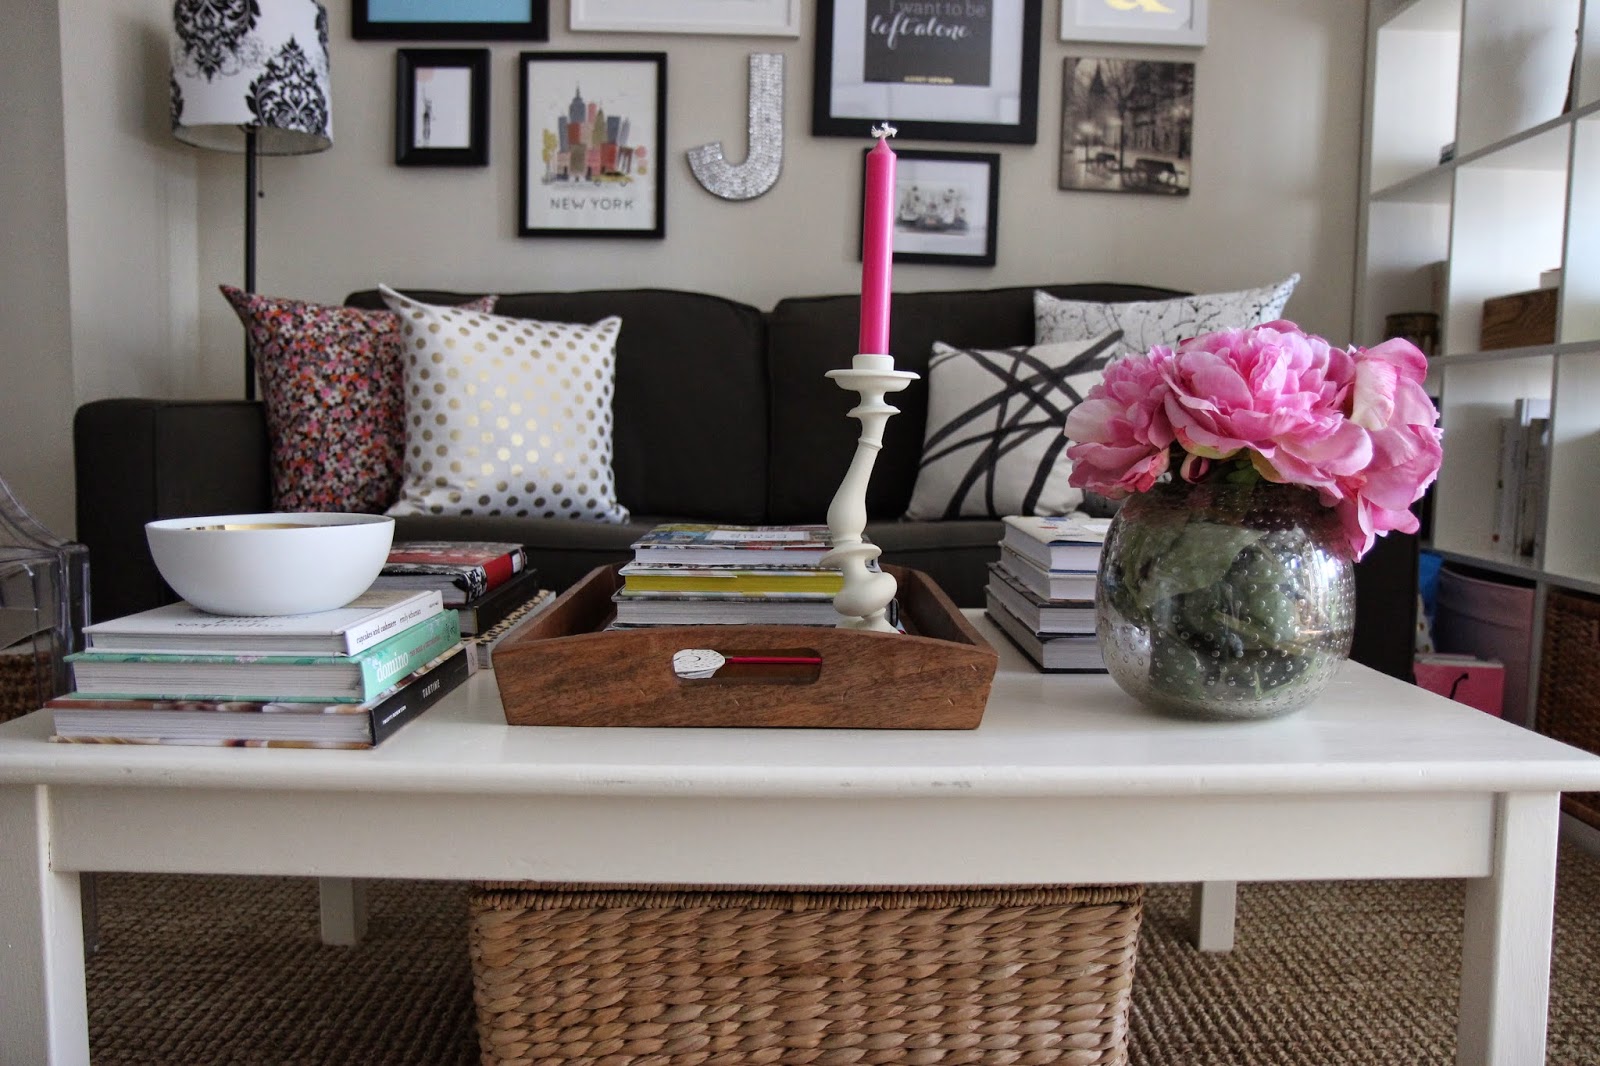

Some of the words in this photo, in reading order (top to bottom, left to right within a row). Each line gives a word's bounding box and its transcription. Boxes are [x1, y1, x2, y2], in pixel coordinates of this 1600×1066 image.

[904, 2, 941, 15] want
[945, 0, 962, 15] to
[966, 0, 986, 17] be
[871, 10, 914, 50] left
[914, 17, 969, 40] alone
[686, 53, 784, 200] J
[550, 197, 586, 210] NEW
[590, 197, 635, 210] YORK
[356, 631, 373, 645] cupcakes
[377, 652, 408, 683] domino
[422, 679, 440, 698] TARTINE
